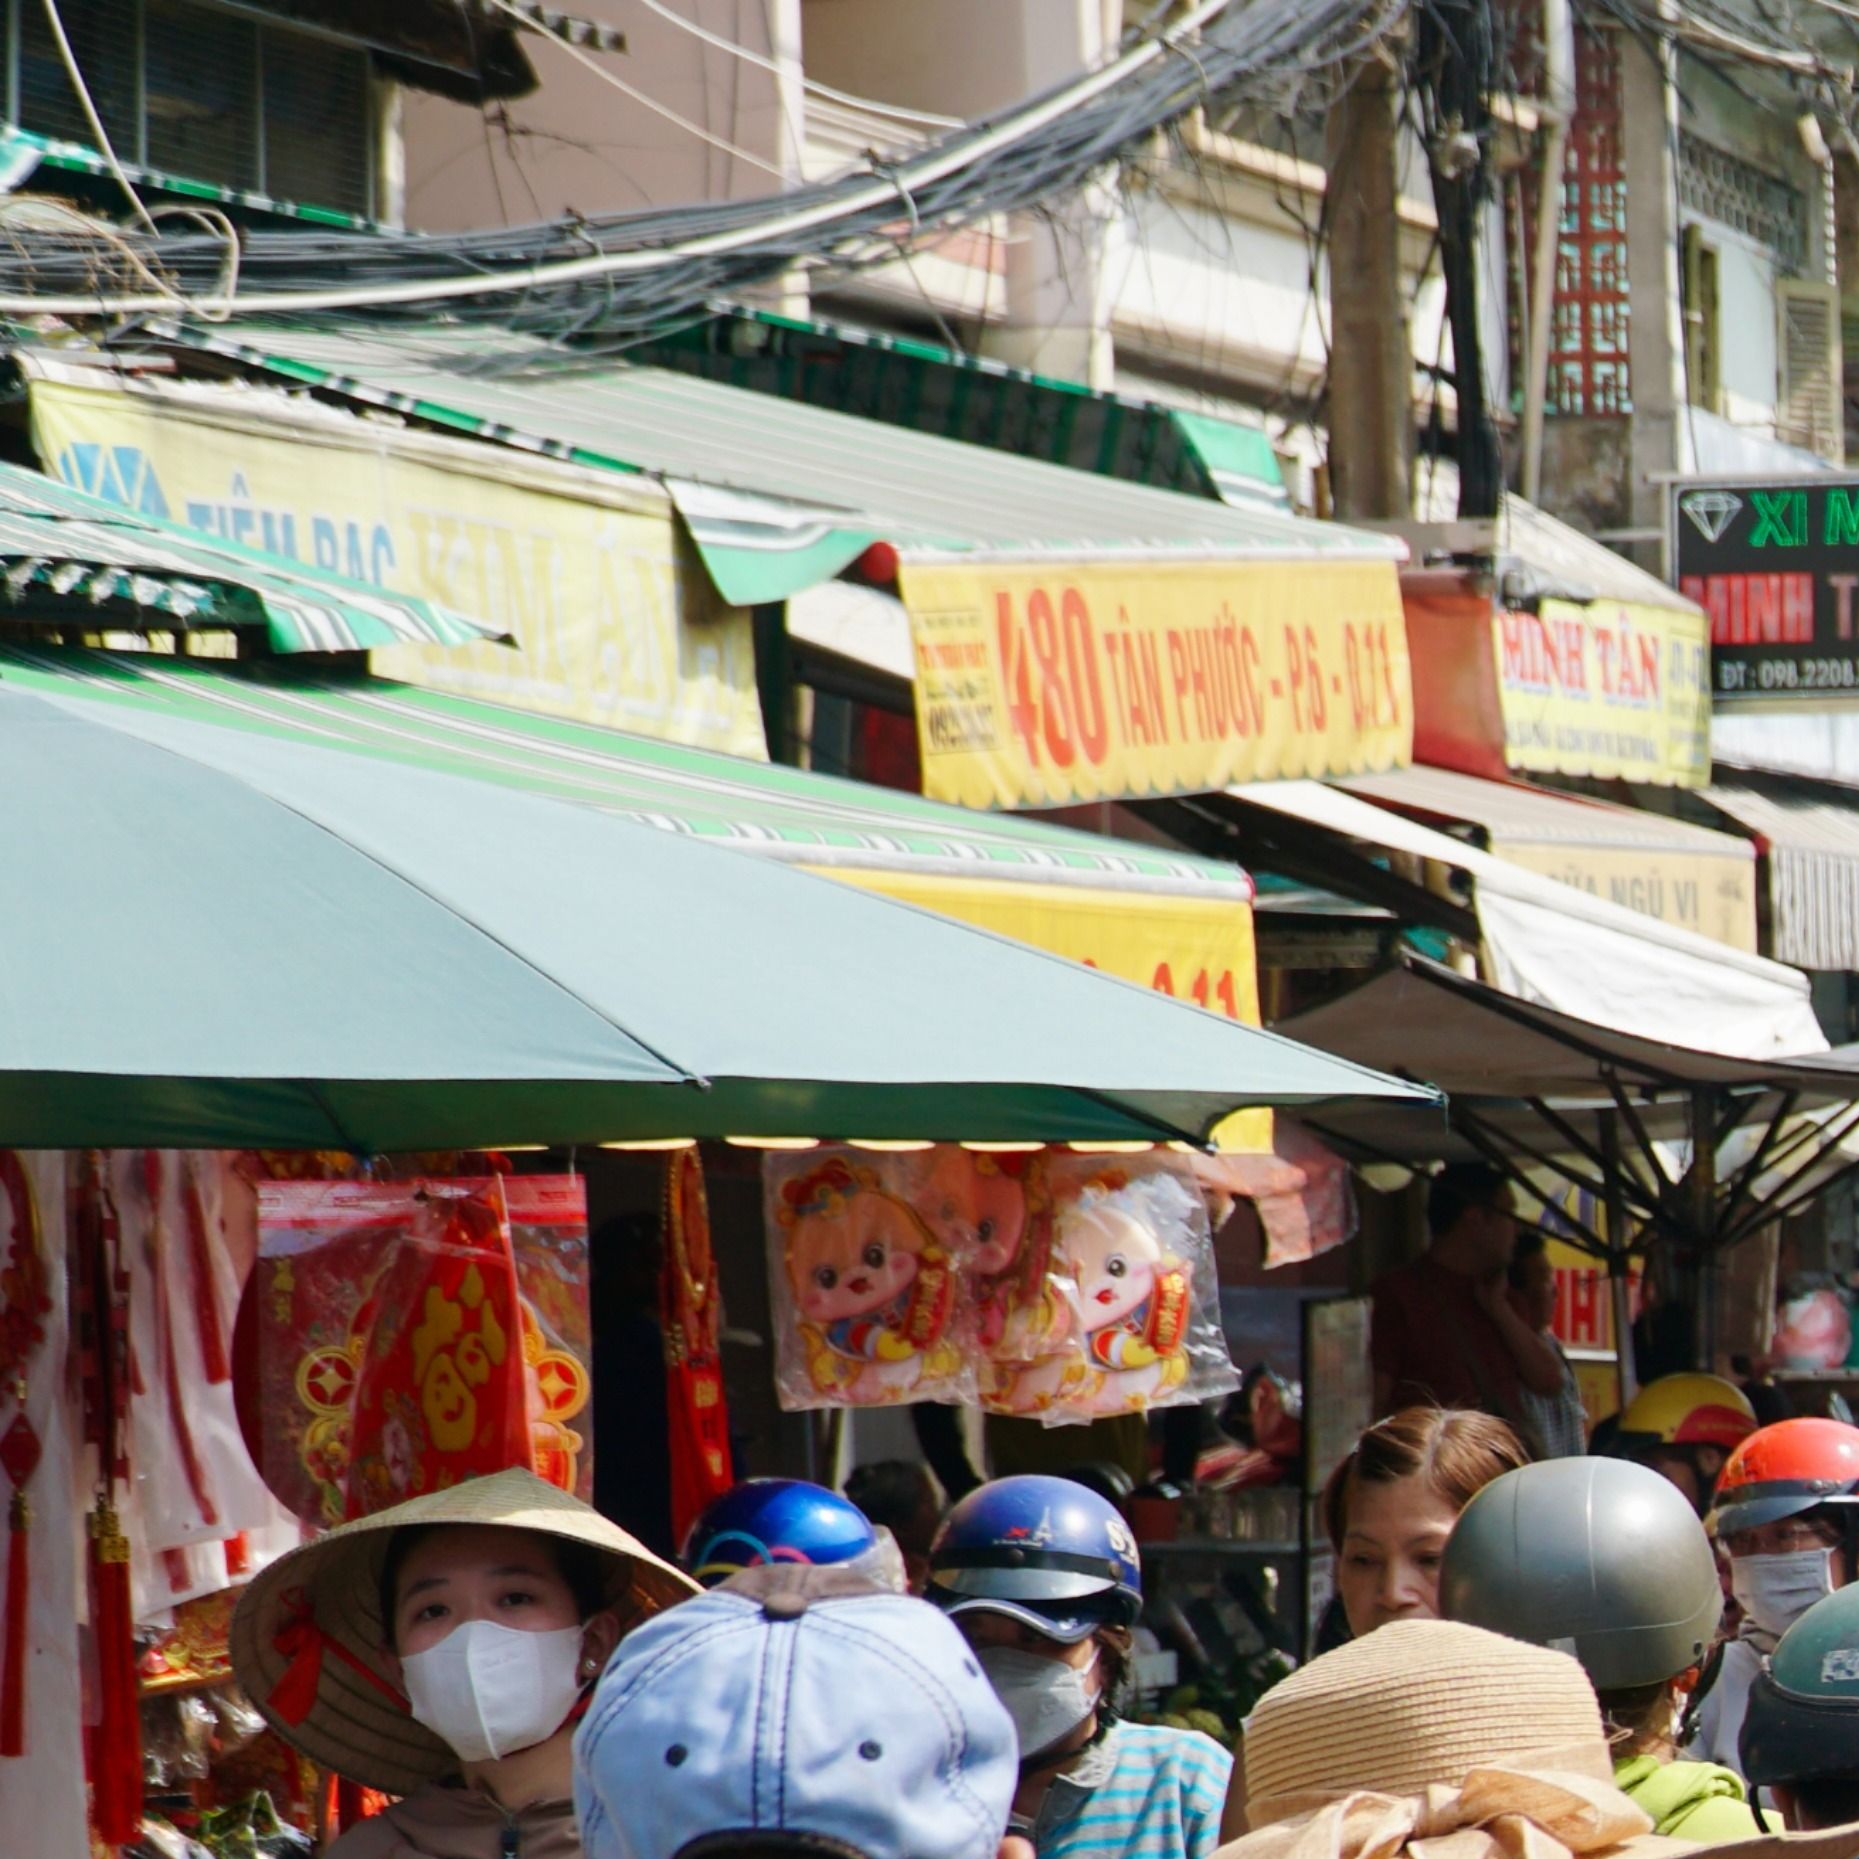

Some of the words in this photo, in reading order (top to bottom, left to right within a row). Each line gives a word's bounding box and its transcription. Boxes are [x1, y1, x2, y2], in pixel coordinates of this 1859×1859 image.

[1748, 488, 1809, 548] XI
[1681, 571, 1815, 645] MINH
[995, 586, 1110, 769] 480
[1103, 602, 1170, 748] TÂN
[1166, 599, 1267, 743] PHƯỚC
[1500, 611, 1589, 694] MINH
[1595, 608, 1662, 704] TÂN
